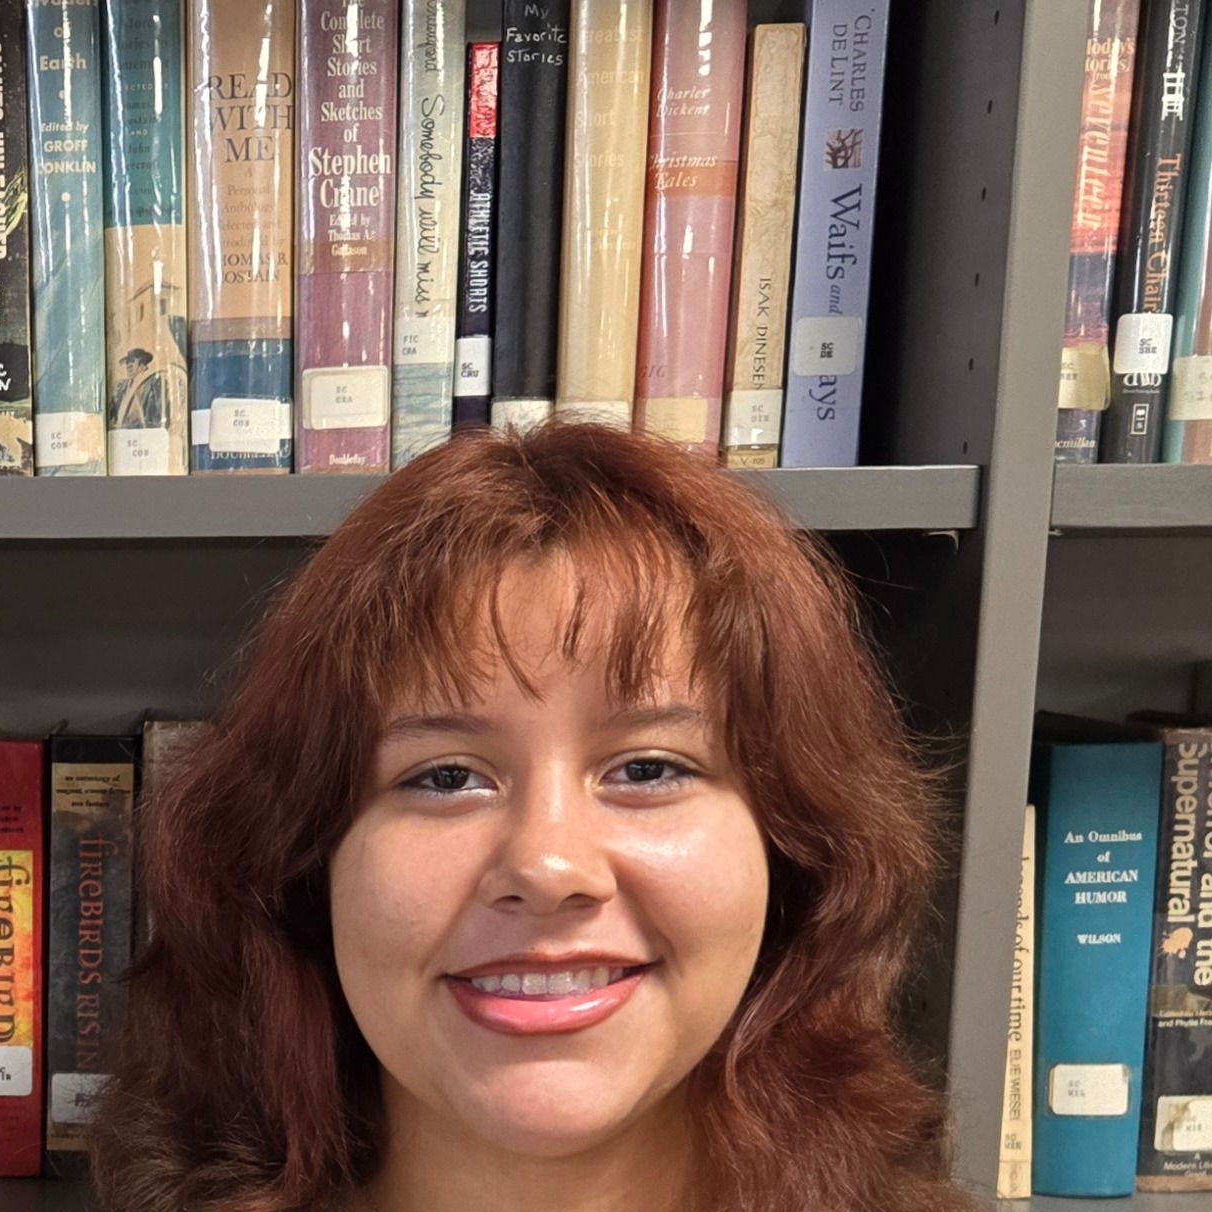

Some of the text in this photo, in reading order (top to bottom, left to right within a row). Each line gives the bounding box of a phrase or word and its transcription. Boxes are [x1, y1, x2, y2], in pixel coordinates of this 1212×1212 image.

[524, 4, 550, 19] My
[321, 10, 384, 34] Colete
[332, 35, 373, 55] Shrt
[506, 24, 567, 46] Favorite
[1087, 36, 1136, 58] Today's
[327, 56, 378, 78] Stories
[849, 14, 872, 112] CHARLES
[338, 79, 365, 99] and
[658, 87, 711, 103] Charles
[321, 101, 384, 123] Sketches
[656, 104, 710, 118] Dickens
[41, 121, 89, 134] Edited by
[343, 122, 359, 144] of
[44, 139, 88, 153] GROFF
[225, 135, 276, 163] ME
[309, 145, 392, 177] Stephen
[655, 171, 699, 190] Tales
[414, 94, 445, 302] Somebody miss
[1150, 153, 1182, 246] Thirteen
[278, 252, 289, 266] B.
[468, 190, 490, 313] ATHLETIC SHORTS
[825, 183, 862, 315] Waifs and
[757, 277, 772, 316] ISAK
[1139, 337, 1153, 346] SC
[460, 370, 479, 378] CRU
[461, 362, 474, 371] SC
[1064, 830, 1143, 844] An Omnibus
[1167, 743, 1199, 924] Supernatural
[1097, 850, 1112, 864] of
[1064, 868, 1139, 885] AMERICAN
[1074, 889, 1127, 905] HUMOR
[1076, 933, 1122, 945] WILSON
[1008, 996, 1026, 1042] time
